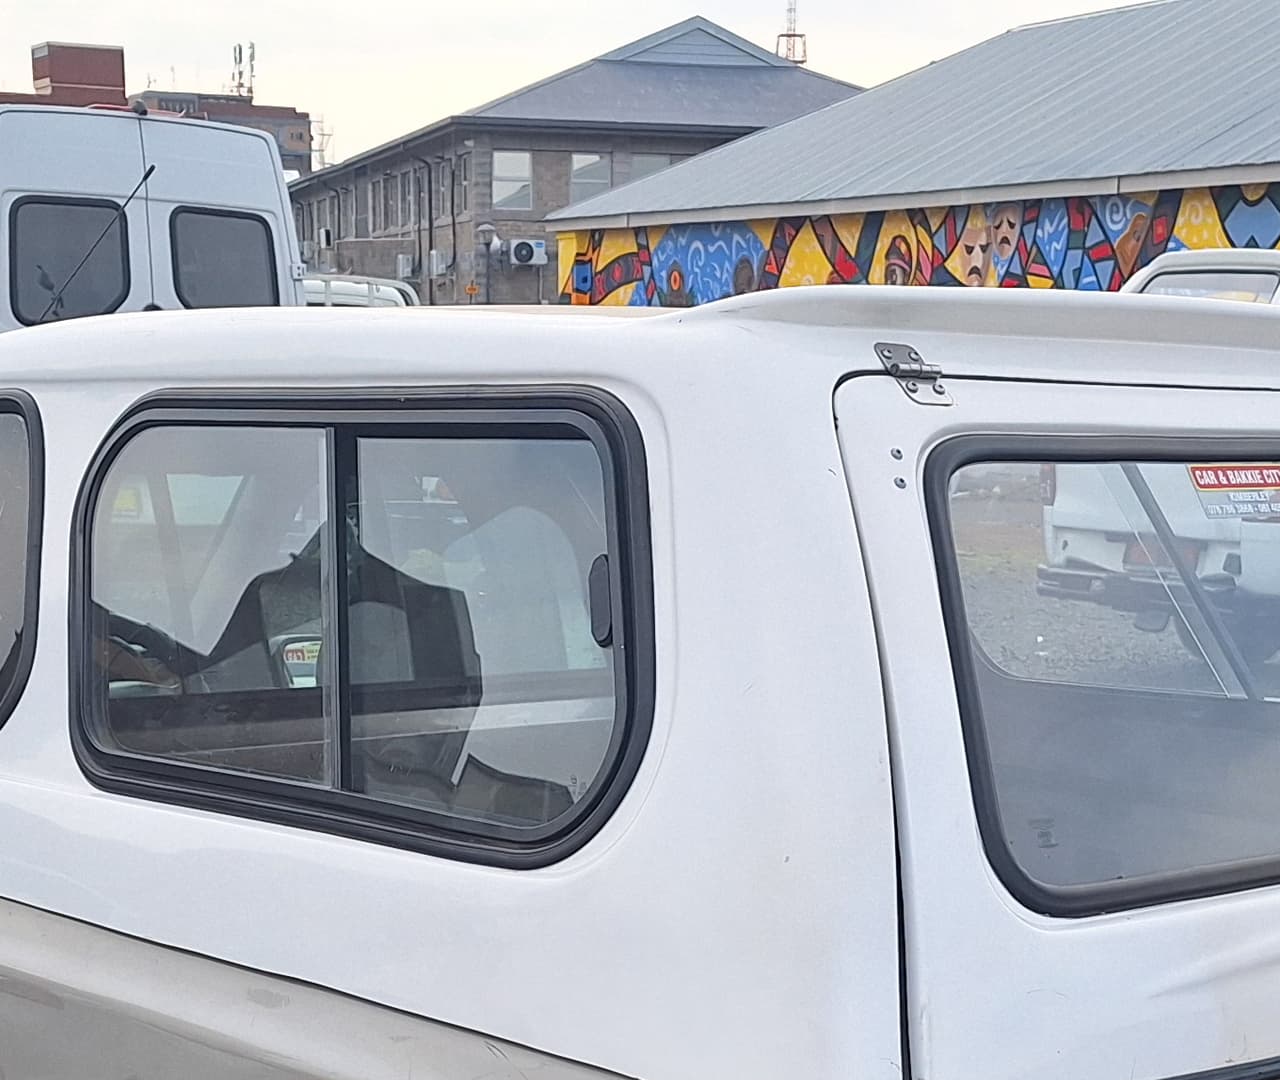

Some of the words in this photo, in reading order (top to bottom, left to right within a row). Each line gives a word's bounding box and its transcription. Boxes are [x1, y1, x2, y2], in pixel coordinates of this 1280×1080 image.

[1195, 470, 1219, 485] CAR
[1217, 470, 1229, 485] &
[1226, 470, 1265, 484] BAKKIE
